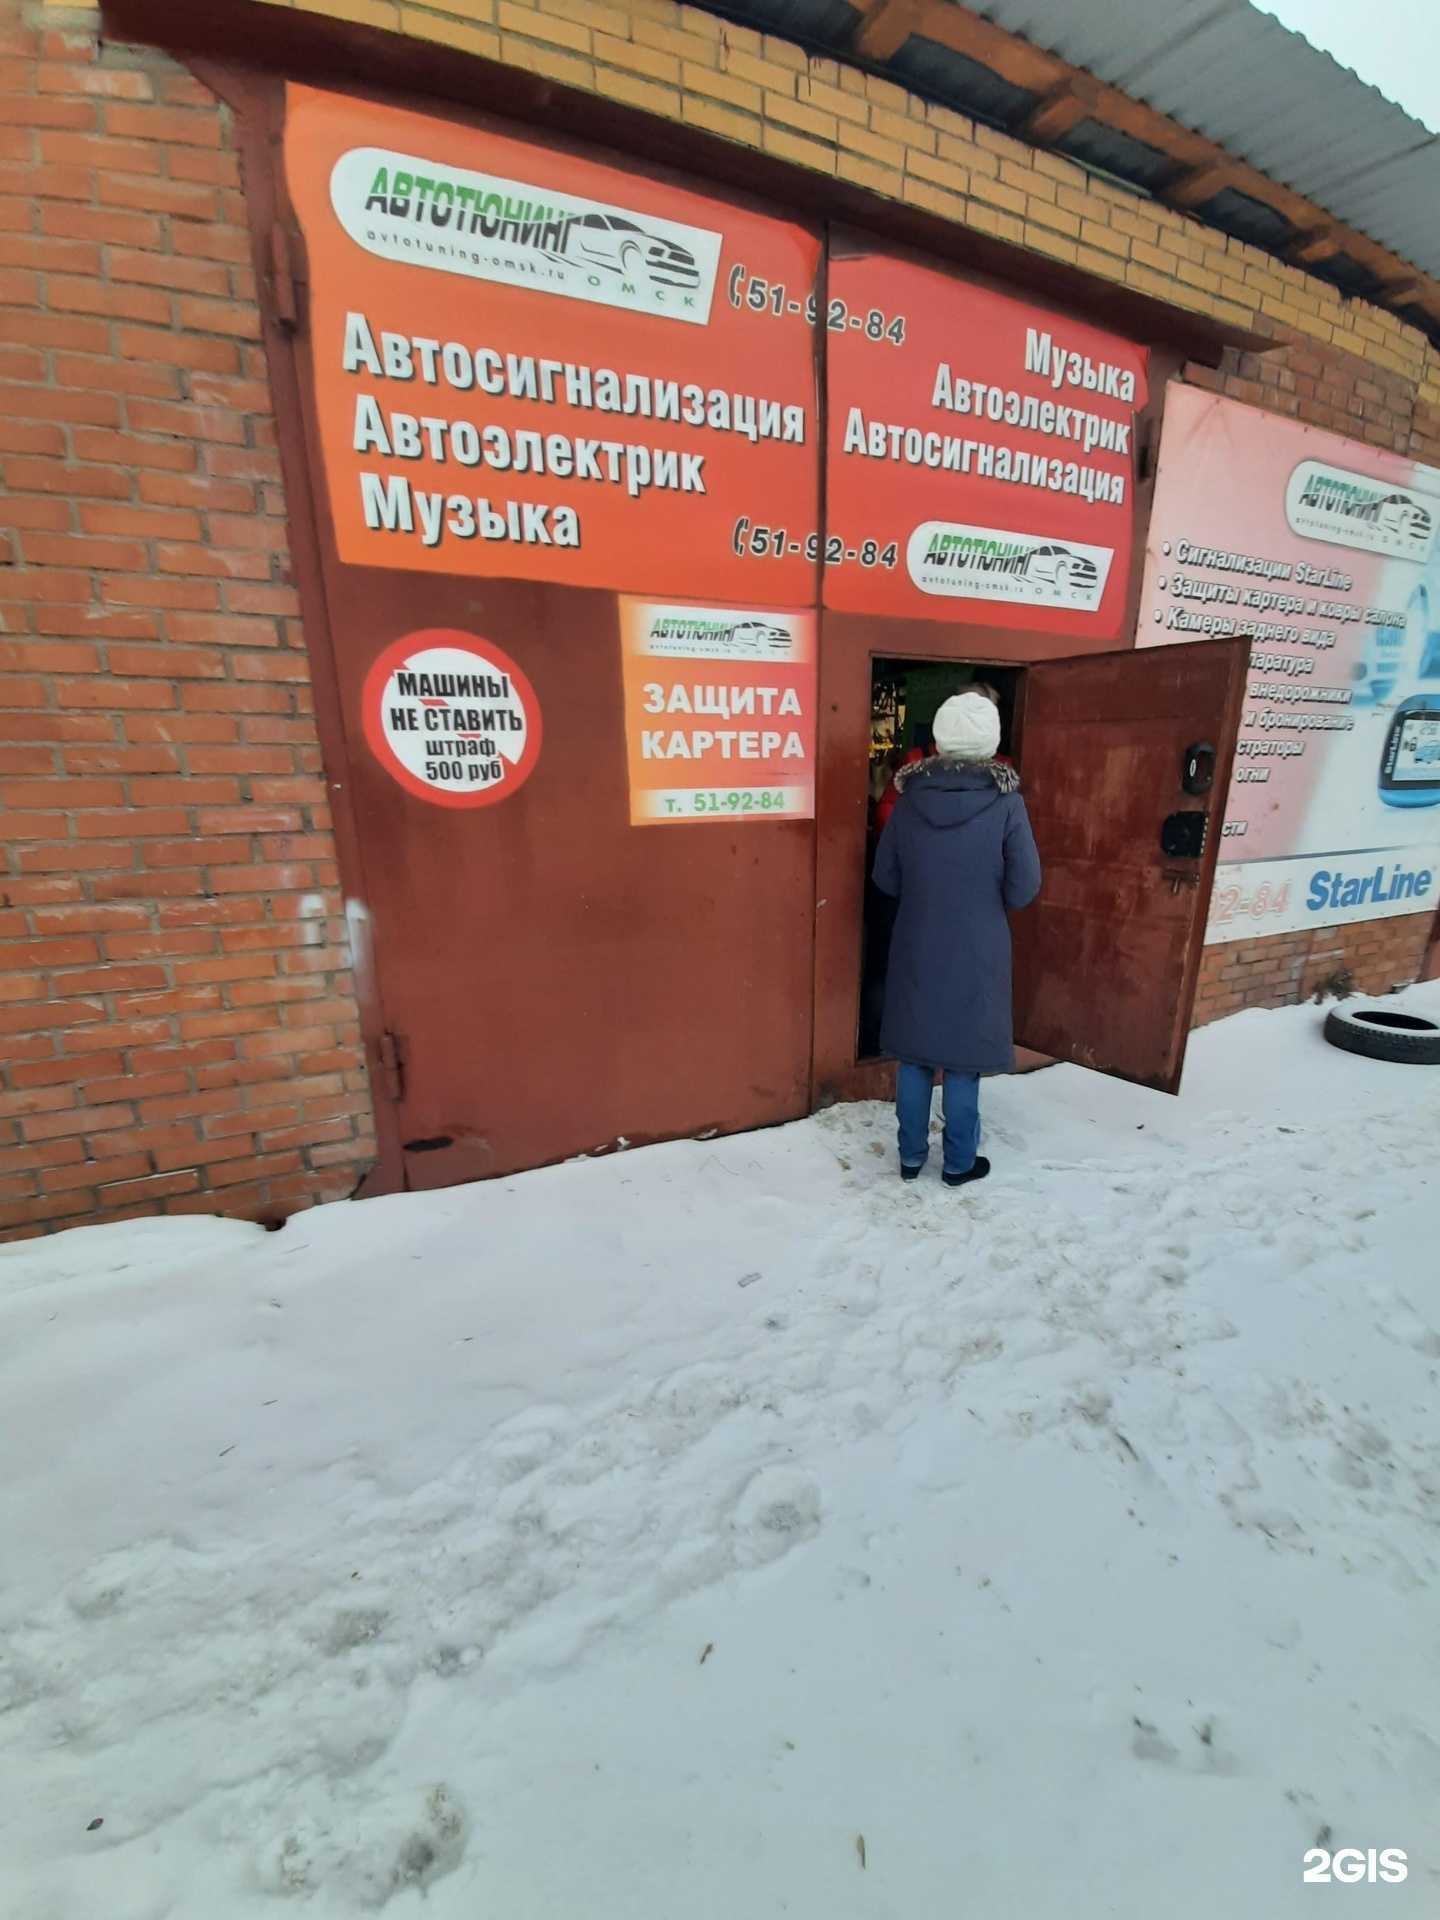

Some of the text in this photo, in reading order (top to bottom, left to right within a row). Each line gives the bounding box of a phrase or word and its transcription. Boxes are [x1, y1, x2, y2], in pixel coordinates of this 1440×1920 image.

[365, 166, 582, 255] АВТОТЮНИНГ
[342, 311, 806, 446] Автосигнализация
[1025, 327, 1135, 402] Музыка
[932, 362, 1131, 455] Автоэлектрик
[353, 393, 706, 496] Автоэлектрик
[843, 406, 1125, 505] Автосигнализация
[359, 472, 581, 547] Музыка
[751, 527, 898, 568] 51-92-84
[923, 533, 1034, 576] АВТОТЮНИНГ
[1175, 538, 1353, 591] Сигнализации StarLine
[1171, 573, 1240, 605] Защиты
[1241, 589, 1305, 616] картера
[1166, 606, 1336, 648] Камеры заднего вида
[396, 672, 510, 699] МАШИНЫ
[643, 683, 802, 720] ЗАЩИТА
[390, 708, 523, 732] НЕ СТАВИТЬ
[425, 738, 497, 758] штраф
[641, 731, 805, 760] КАРТЕРА
[425, 760, 502, 782] 500 руб
[693, 791, 785, 812] 51-92-84
[1306, 864, 1433, 911] StarLine
